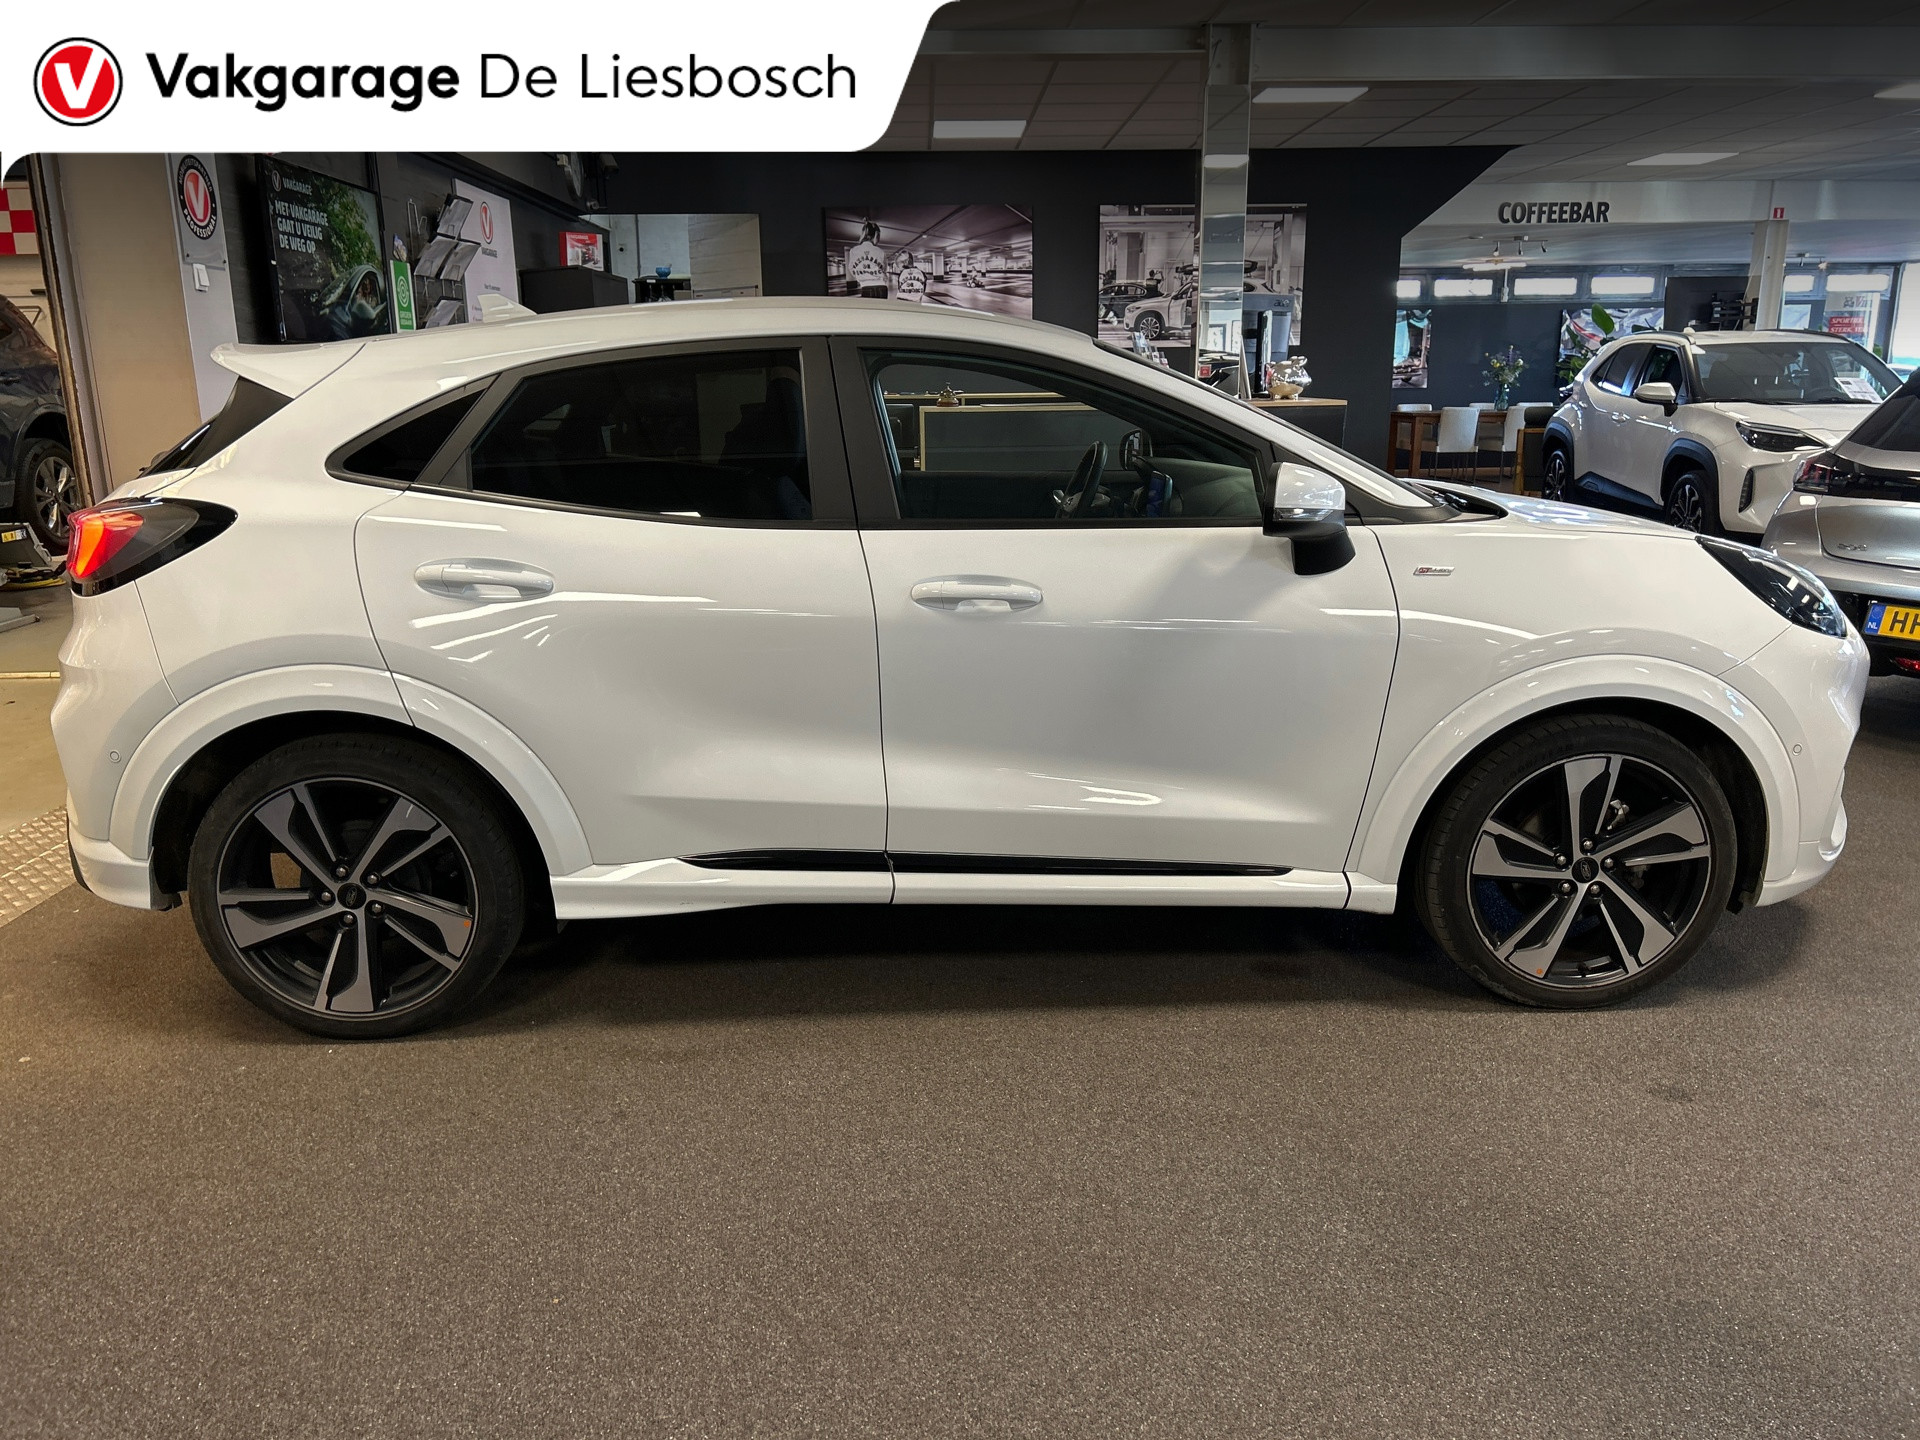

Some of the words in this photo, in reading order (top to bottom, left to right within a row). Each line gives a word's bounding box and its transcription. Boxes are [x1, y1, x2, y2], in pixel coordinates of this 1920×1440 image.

[282, 177, 313, 195] VAKGARAGE
[183, 208, 217, 238] PROFESSIONAL
[290, 204, 329, 226] VAKGARAGE
[1498, 201, 1610, 224] COFFEEBAR
[277, 217, 294, 234] GAAT
[295, 221, 302, 235] U
[301, 223, 323, 240] VEILIG
[279, 234, 290, 249] DE
[289, 236, 306, 252] WEG
[306, 241, 316, 254] OP
[1867, 621, 1878, 630] NL
